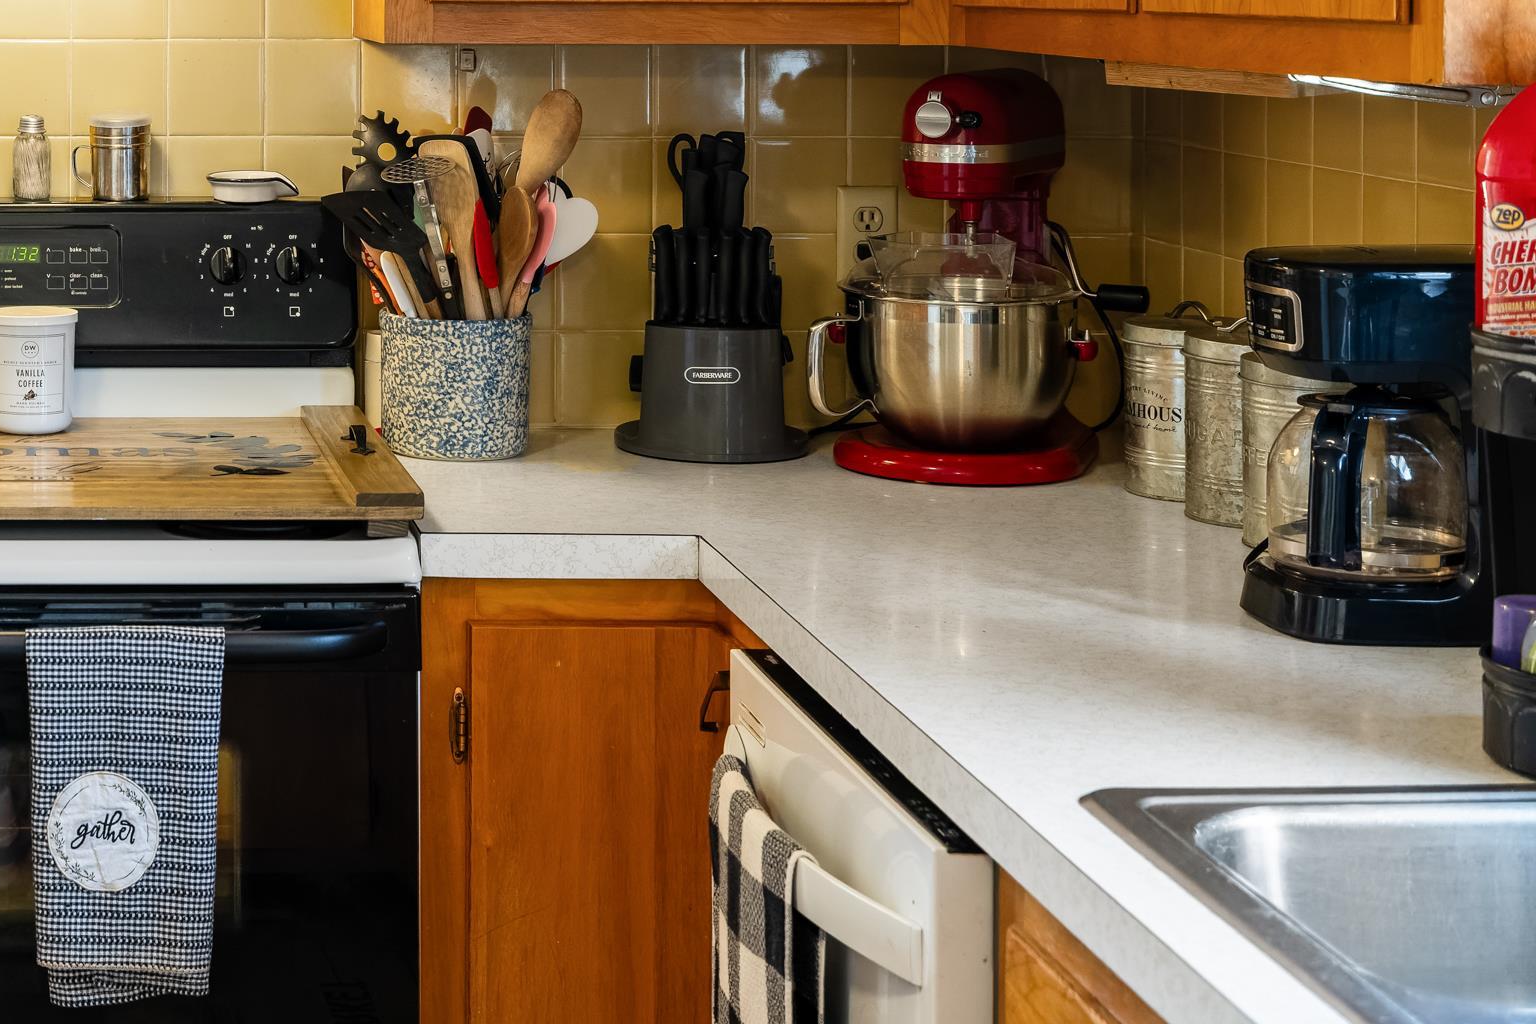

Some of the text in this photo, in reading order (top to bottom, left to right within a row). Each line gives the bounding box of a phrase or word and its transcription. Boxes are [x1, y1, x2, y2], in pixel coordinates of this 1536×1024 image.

[16, 369, 45, 377] VANILLA
[692, 371, 733, 379] FARBERWARE
[18, 379, 43, 387] COFFEE
[70, 810, 136, 850] gather
